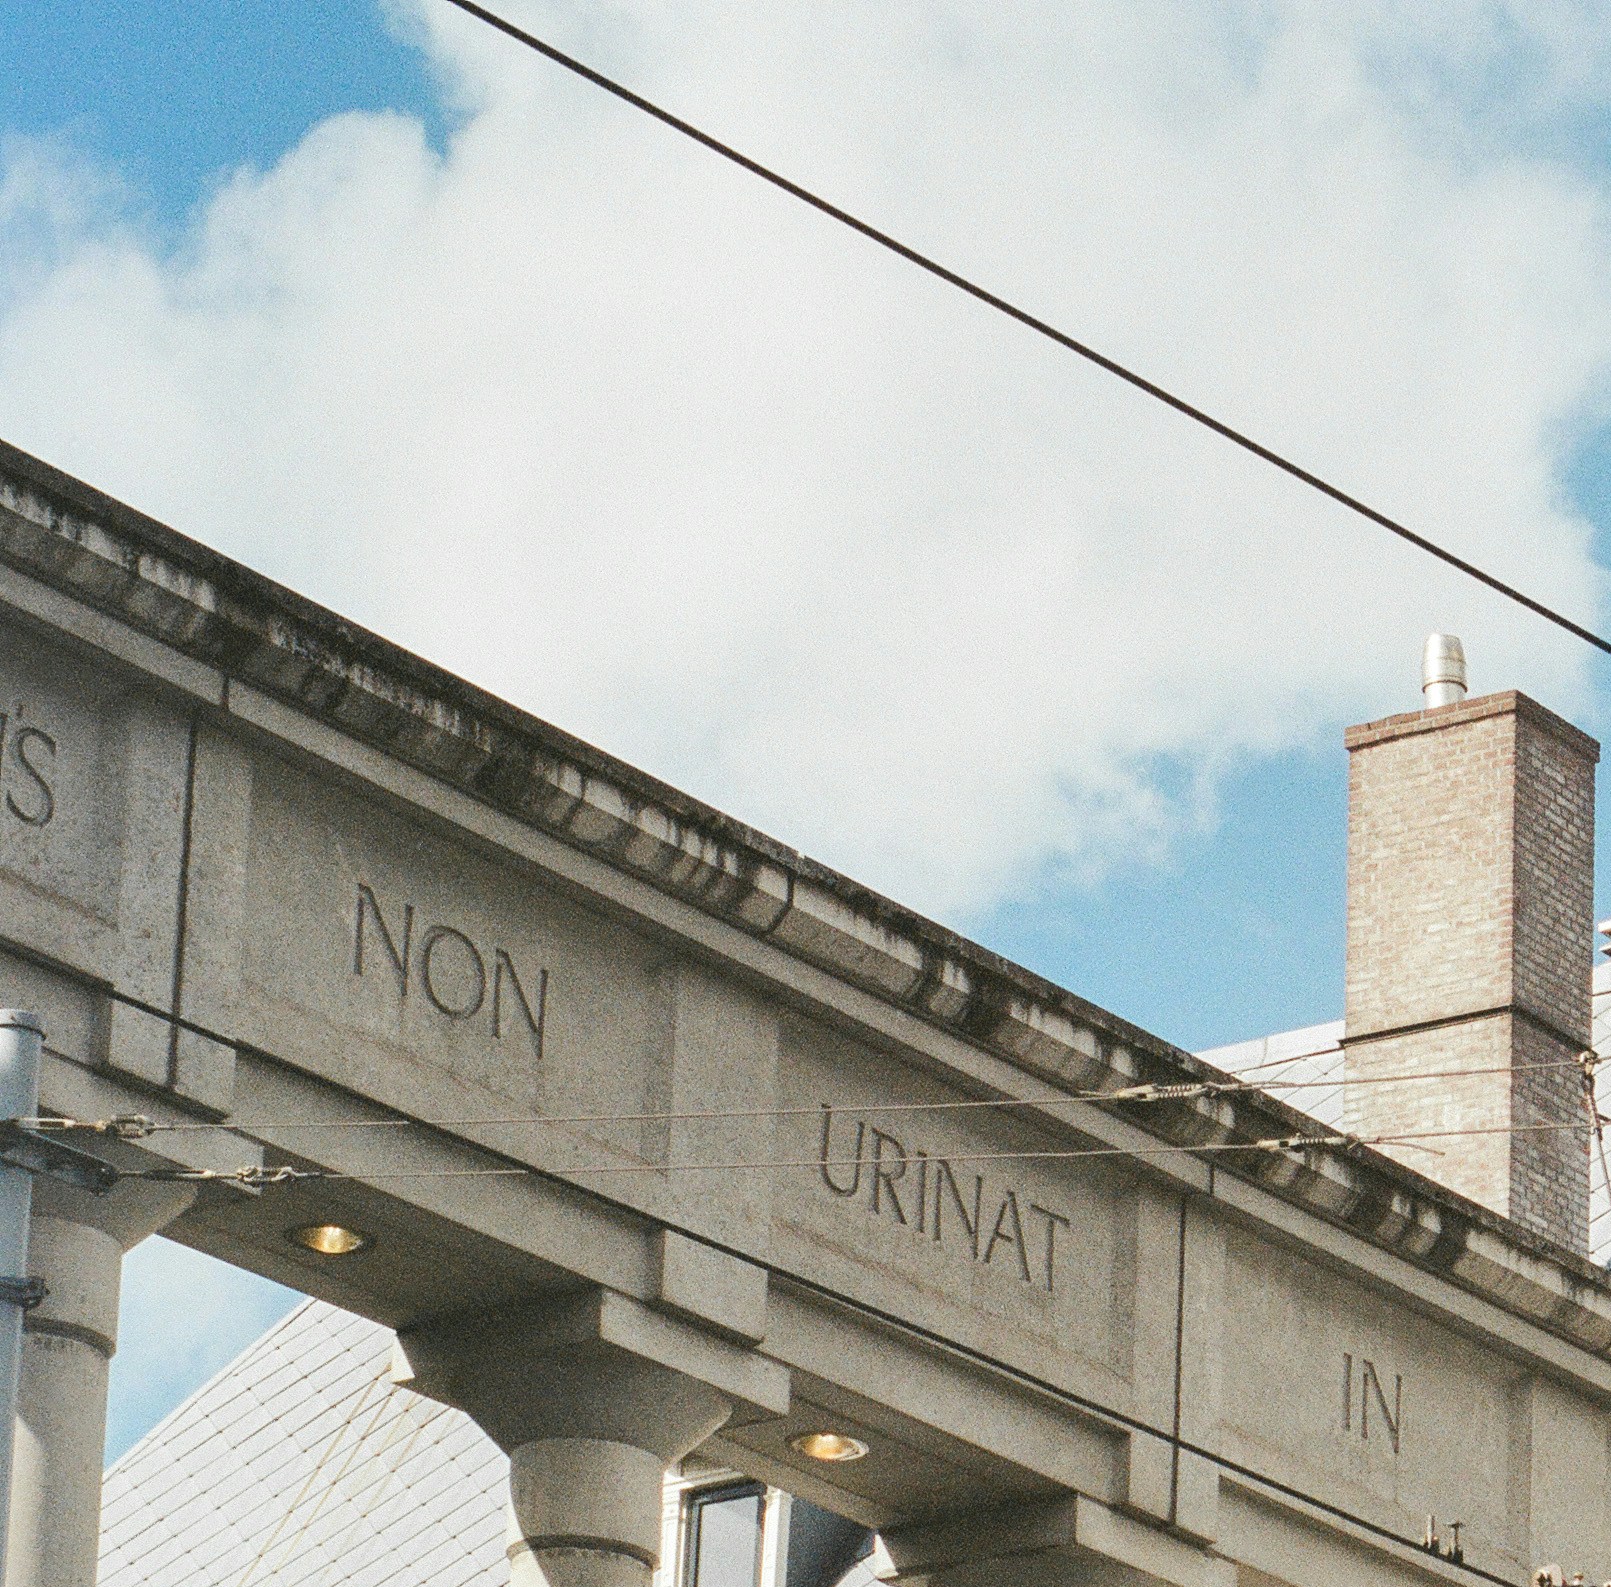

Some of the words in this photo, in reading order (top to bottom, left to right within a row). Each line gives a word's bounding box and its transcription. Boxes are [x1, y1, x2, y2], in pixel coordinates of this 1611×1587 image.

[353, 882, 549, 1060] NON
[819, 1103, 1071, 1292] URINAT
[1342, 1351, 1403, 1455] IN
